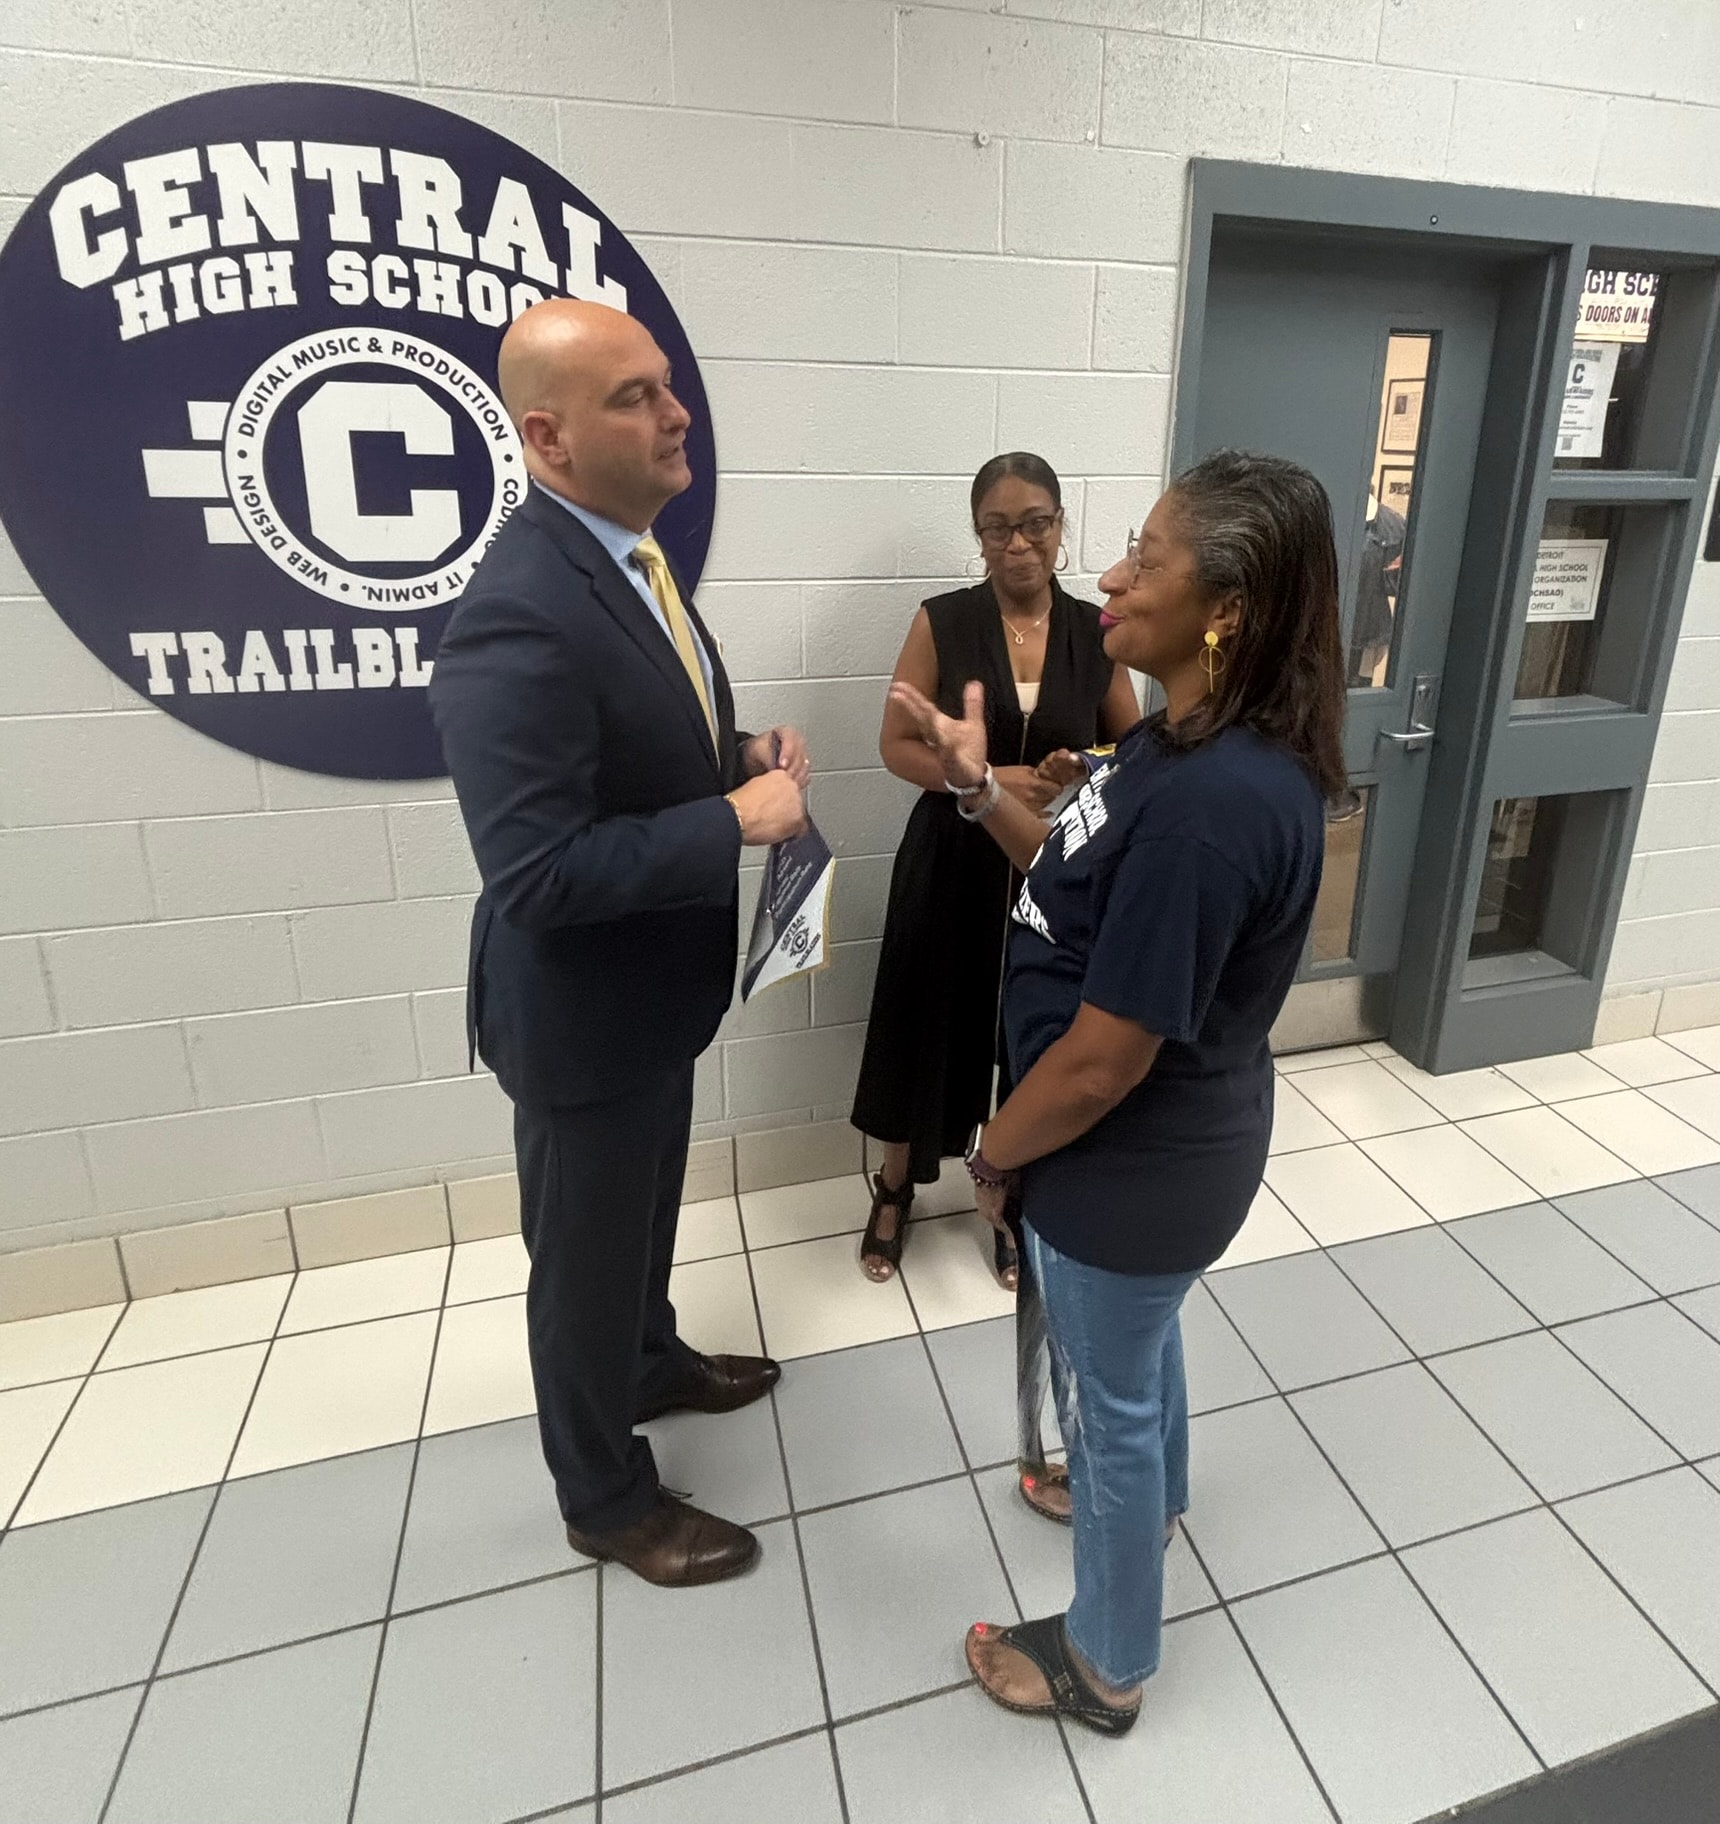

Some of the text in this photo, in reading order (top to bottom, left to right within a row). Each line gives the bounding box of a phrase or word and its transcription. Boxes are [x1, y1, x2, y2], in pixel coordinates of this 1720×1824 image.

[49, 140, 627, 313] CENTRAL
[113, 250, 558, 342] HIGH SCHO
[1583, 270, 1617, 294] GH
[1585, 305, 1622, 323] DOORS
[1624, 306, 1640, 323] ON
[238, 336, 509, 442] DIGITAL MUSIC & PRODUCTION
[1572, 363, 1585, 384] C
[297, 381, 462, 562] C
[238, 474, 328, 586] WEB DESIGN
[1534, 575, 1587, 583] ORGANIZATION
[1540, 563, 1588, 572] HIGH SCHOOL
[361, 571, 465, 602] IT ADMIN.
[1530, 602, 1555, 610] OFFICE
[129, 627, 435, 695] TRAILBL
